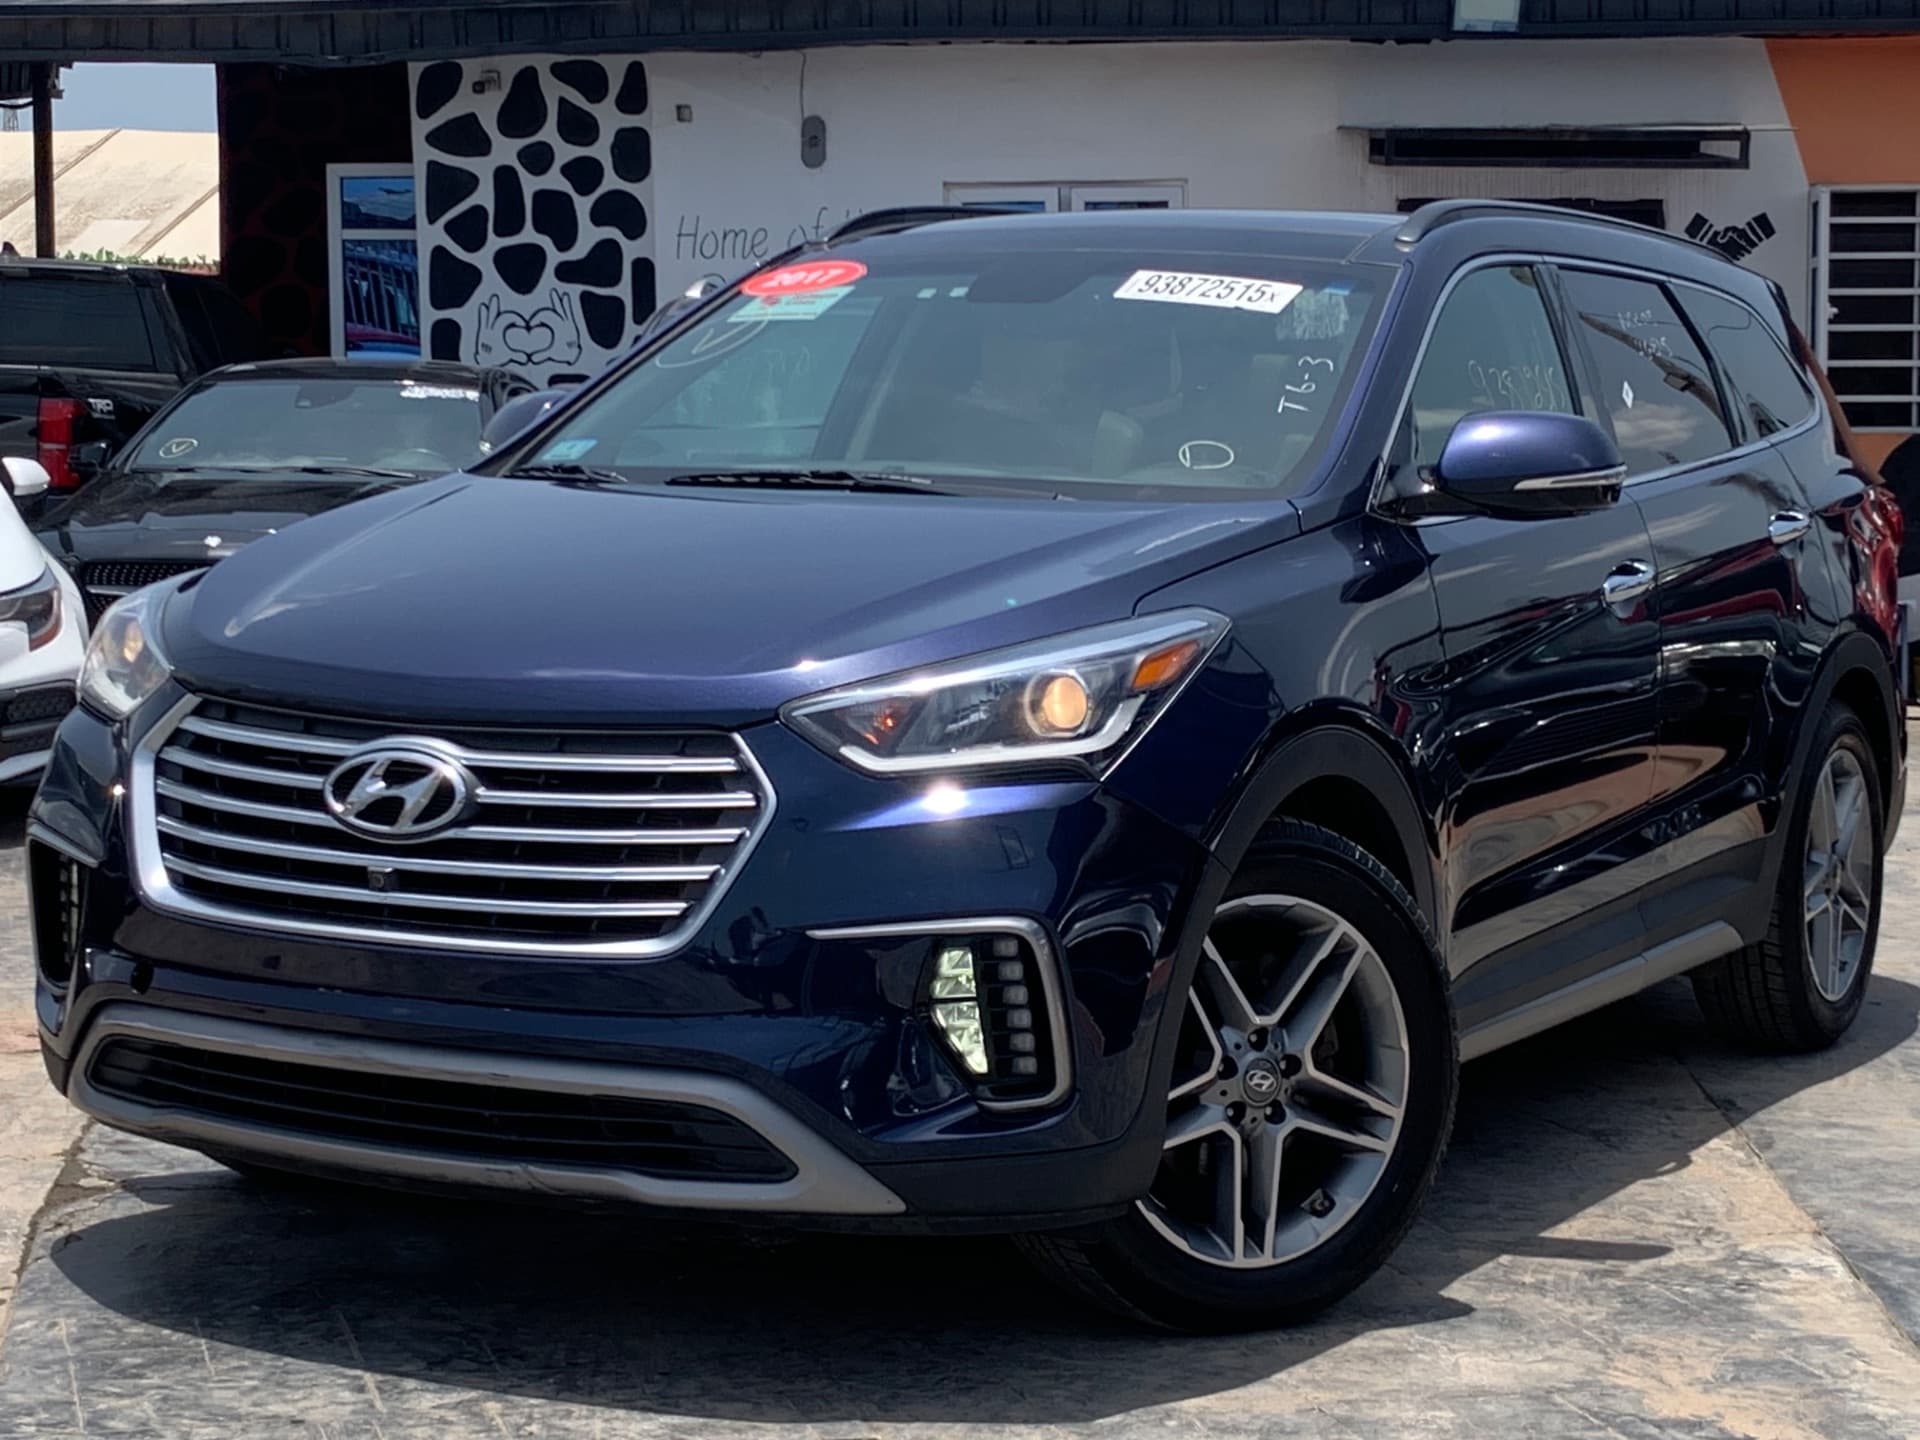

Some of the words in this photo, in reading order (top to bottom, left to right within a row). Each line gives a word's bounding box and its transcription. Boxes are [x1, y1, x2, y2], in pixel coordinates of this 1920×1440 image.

[676, 214, 768, 260] Home
[787, 206, 829, 247] of
[761, 267, 846, 288] 2017
